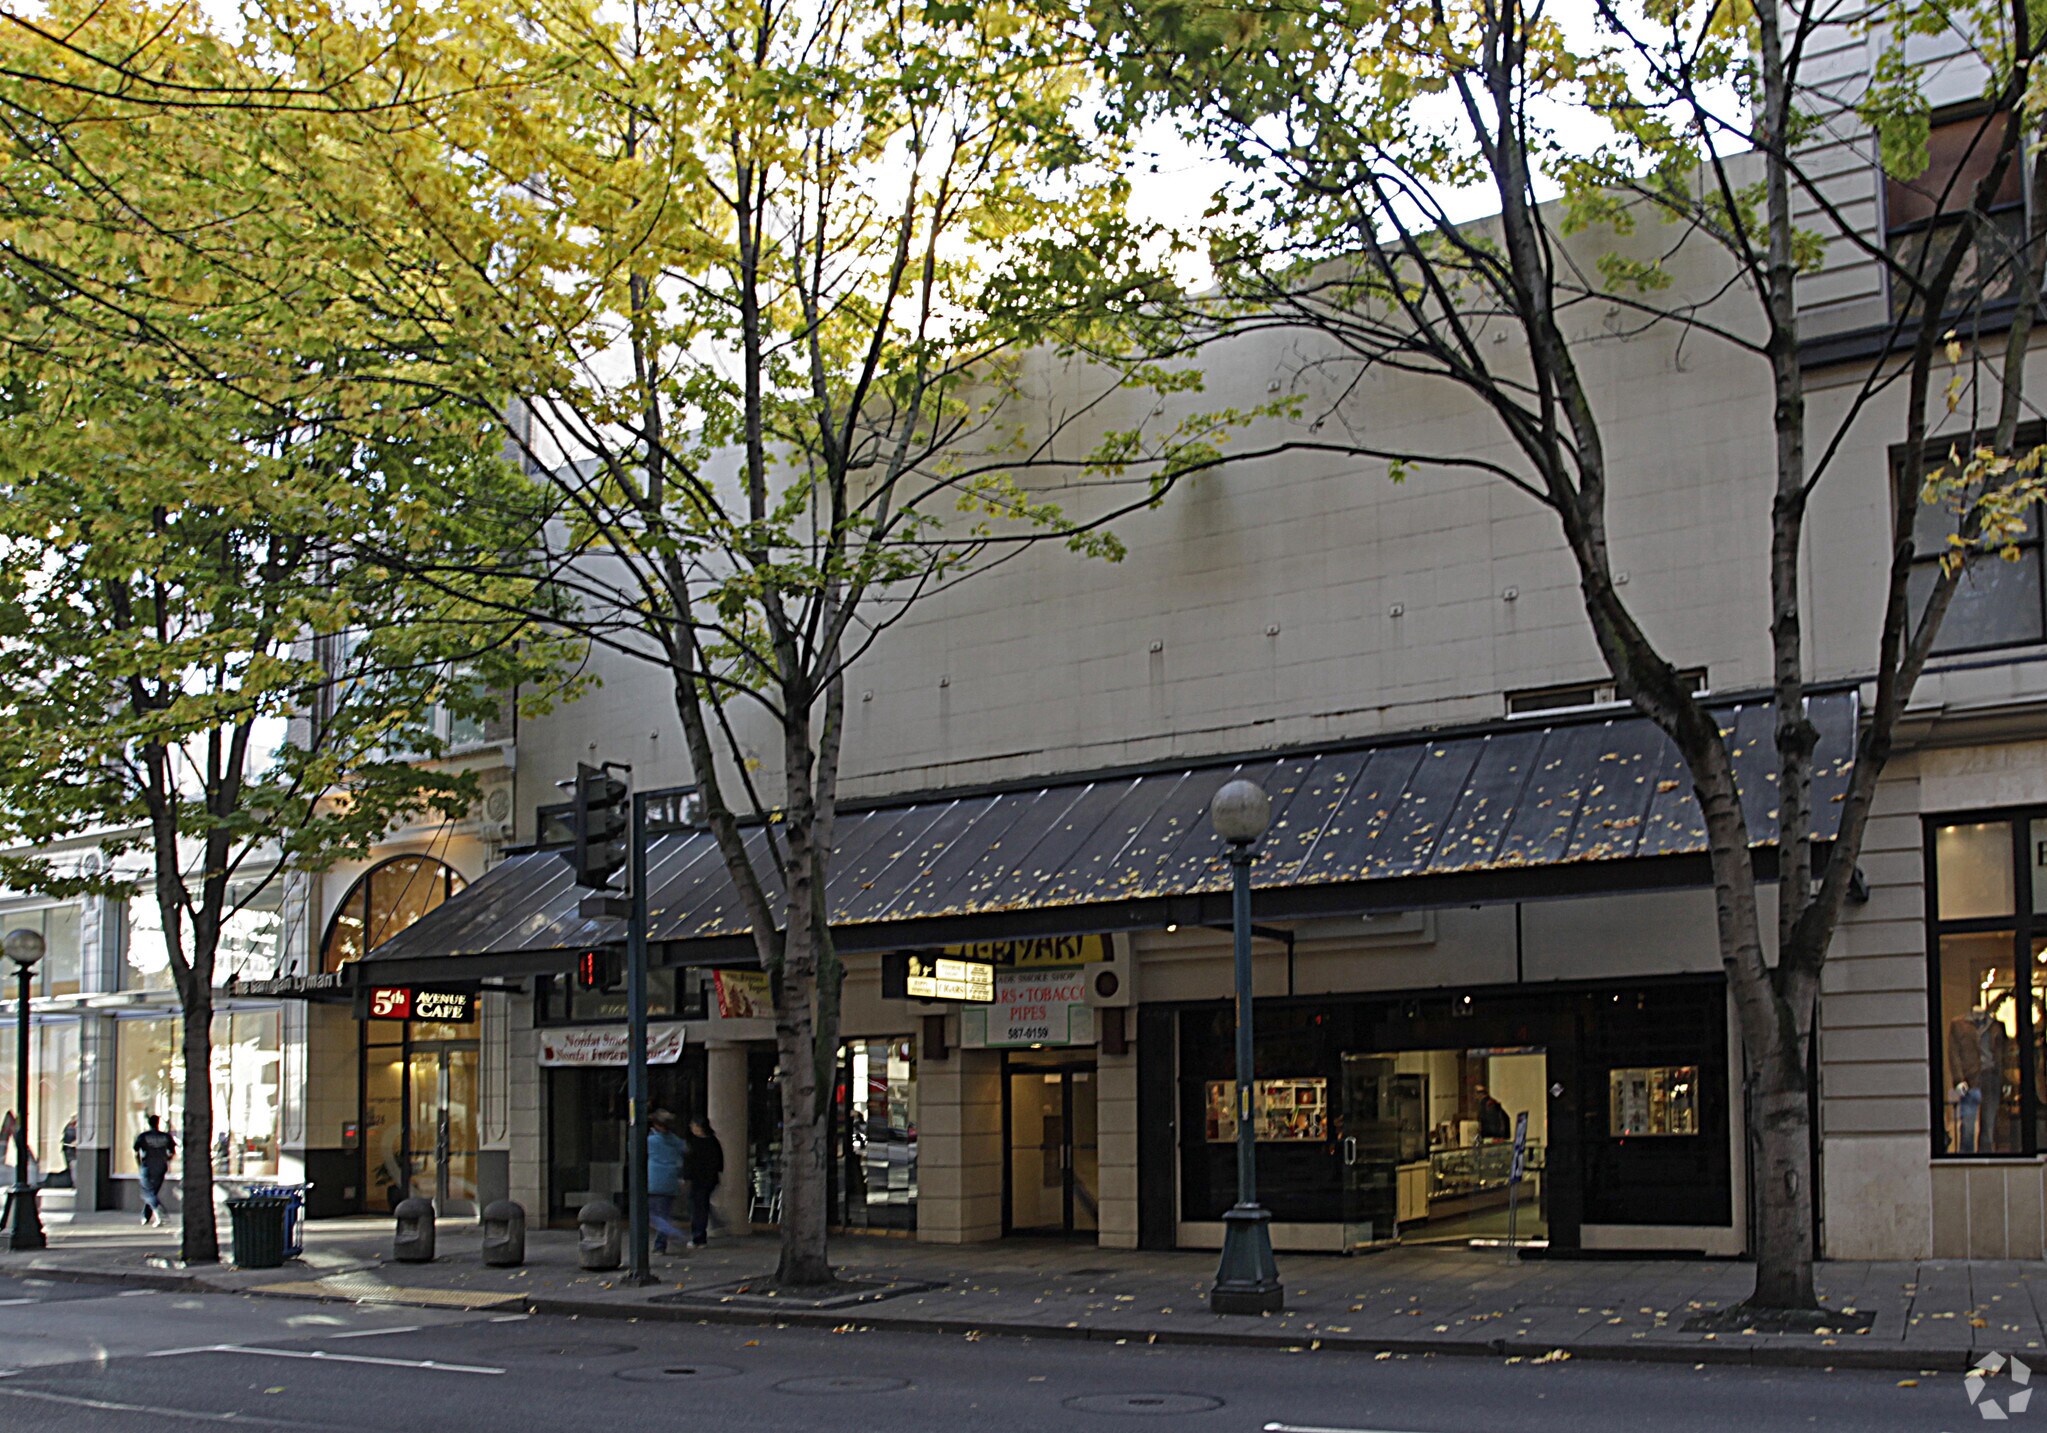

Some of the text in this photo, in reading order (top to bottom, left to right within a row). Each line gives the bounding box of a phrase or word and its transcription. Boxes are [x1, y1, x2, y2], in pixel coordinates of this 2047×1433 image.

[294, 973, 333, 992] Lyman
[373, 990, 405, 1015] 5th
[415, 991, 467, 1005] AVENUE
[995, 987, 1017, 1004] ARS
[416, 1003, 463, 1018] CAFE
[1010, 1005, 1047, 1021] PIPES
[564, 1033, 601, 1048] Nonfat
[555, 1048, 588, 1063] Nonfat
[591, 1048, 628, 1062] Frozen
